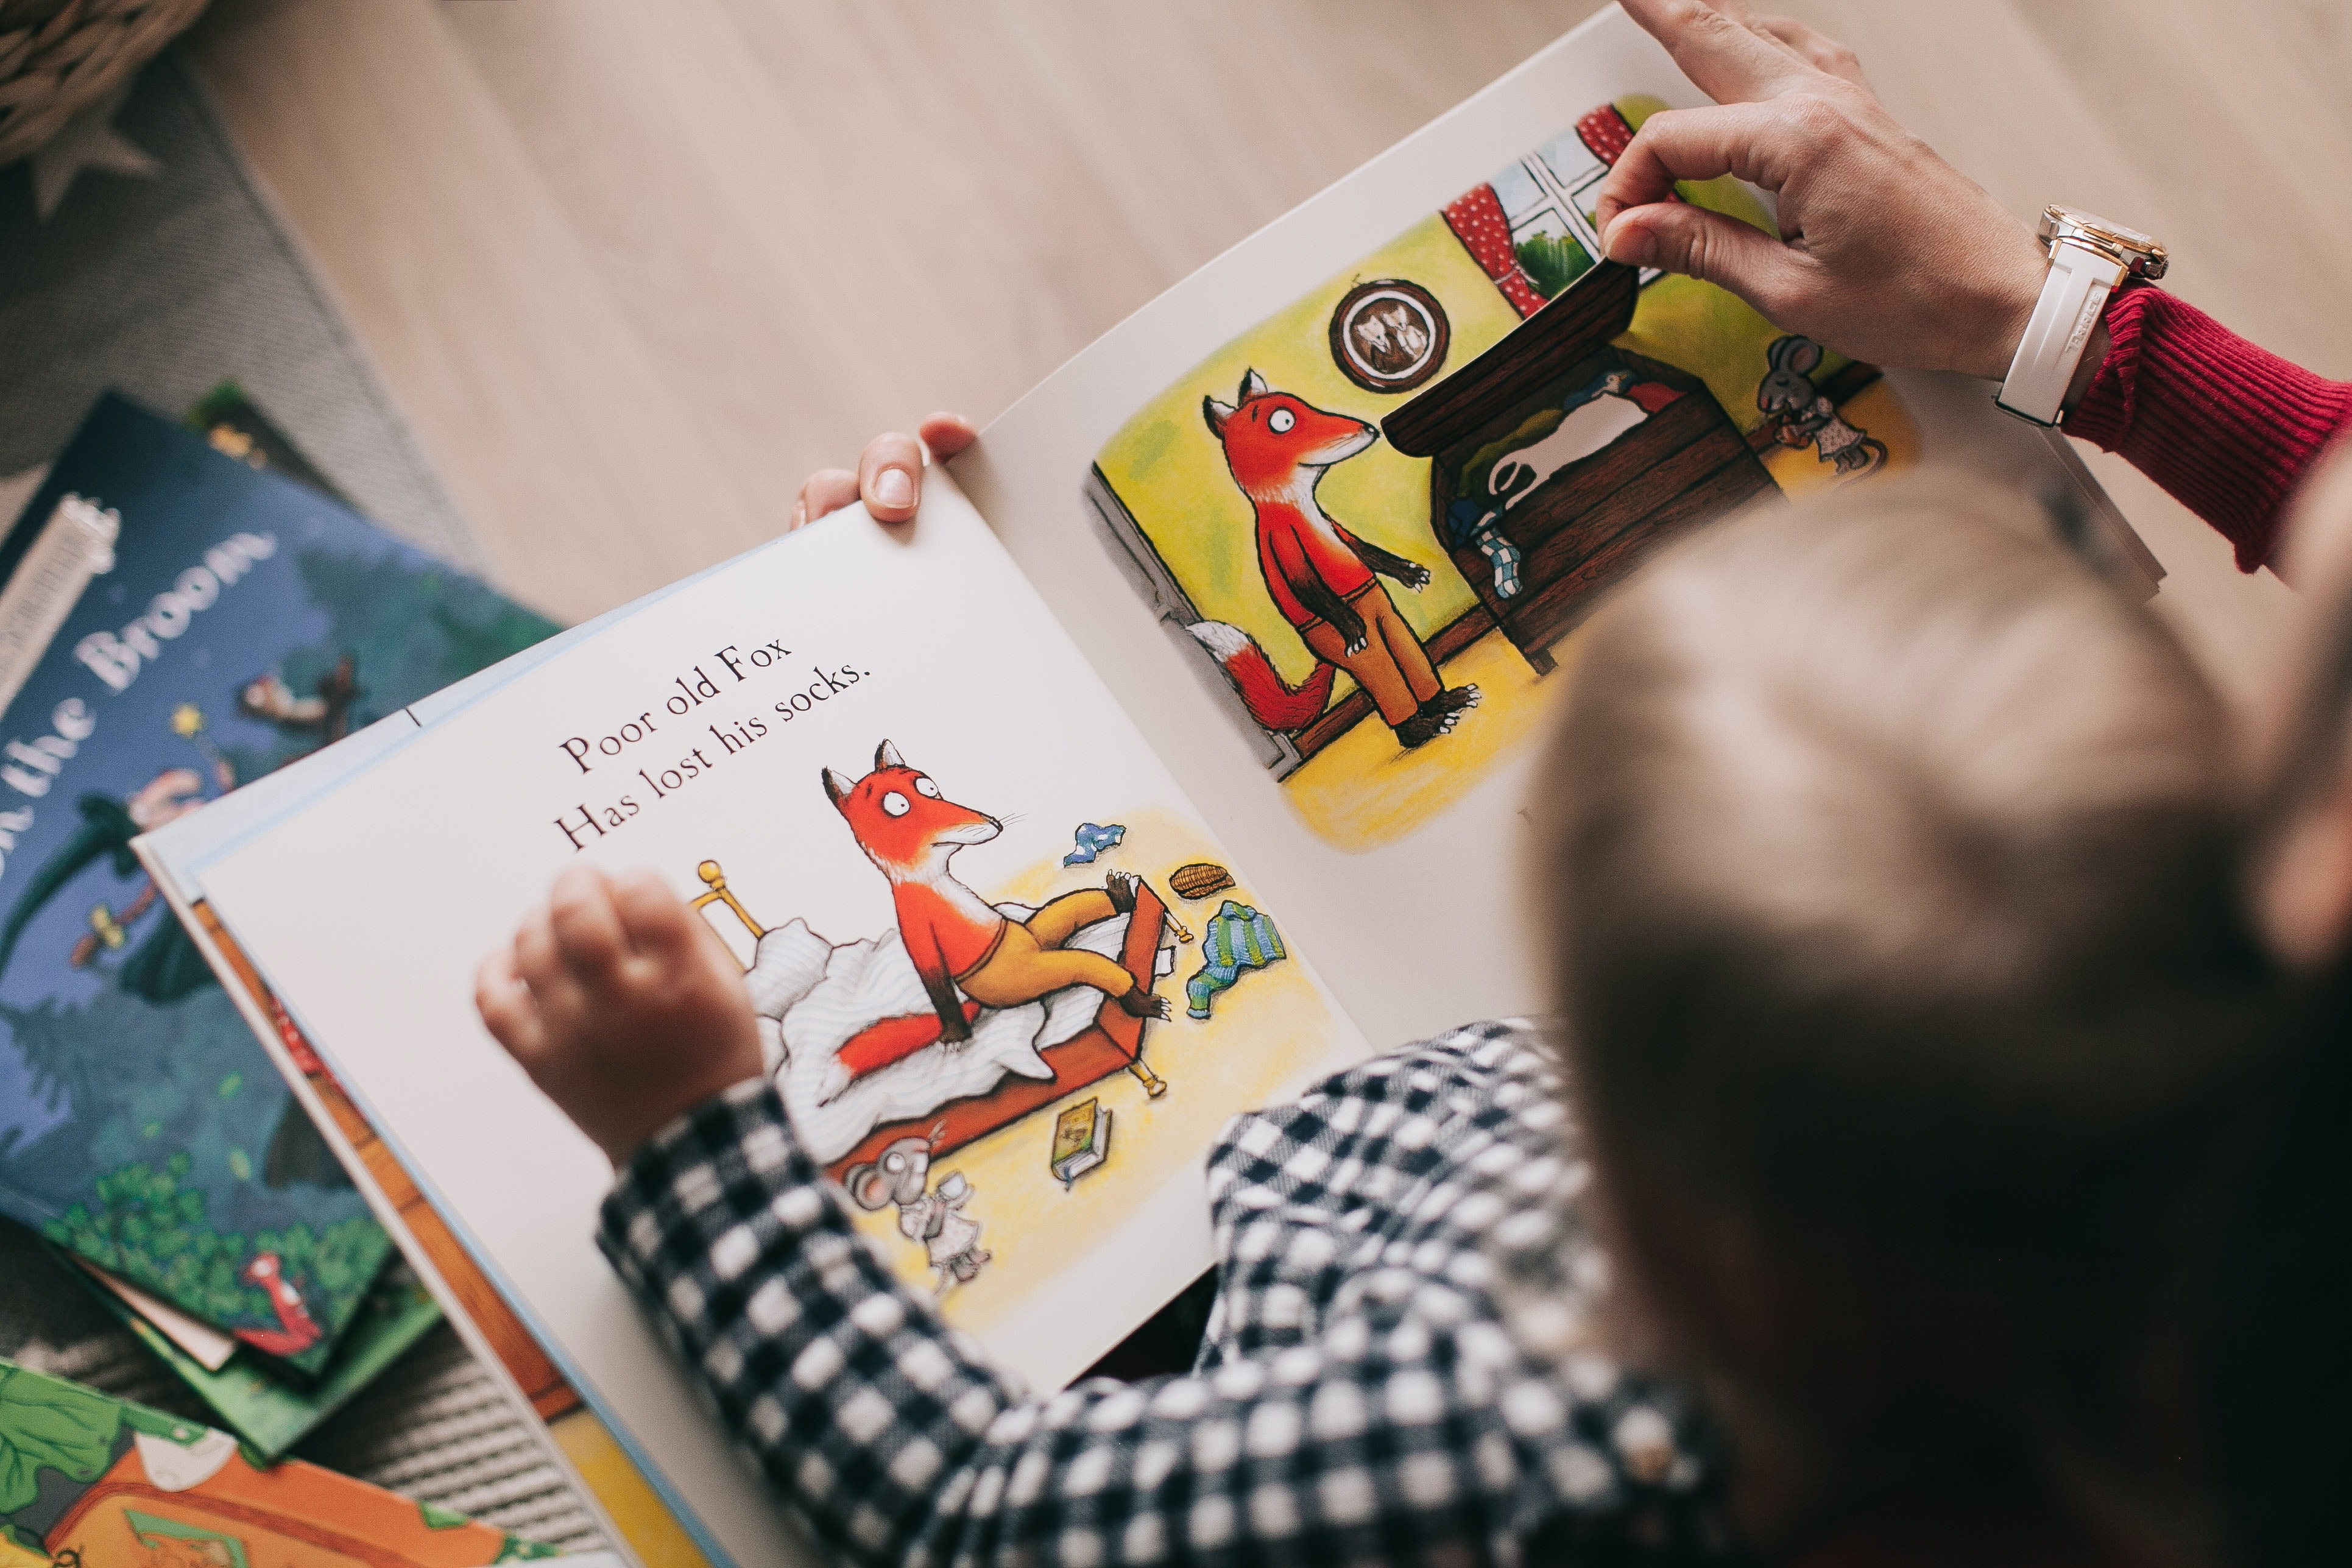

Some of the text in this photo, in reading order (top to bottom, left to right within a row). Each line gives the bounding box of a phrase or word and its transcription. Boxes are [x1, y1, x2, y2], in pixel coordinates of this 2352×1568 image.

[0, 697, 97, 798] the
[73, 531, 278, 692] Broom
[553, 662, 871, 852] Has lost his socks.
[559, 639, 792, 774] Poor old Fox
